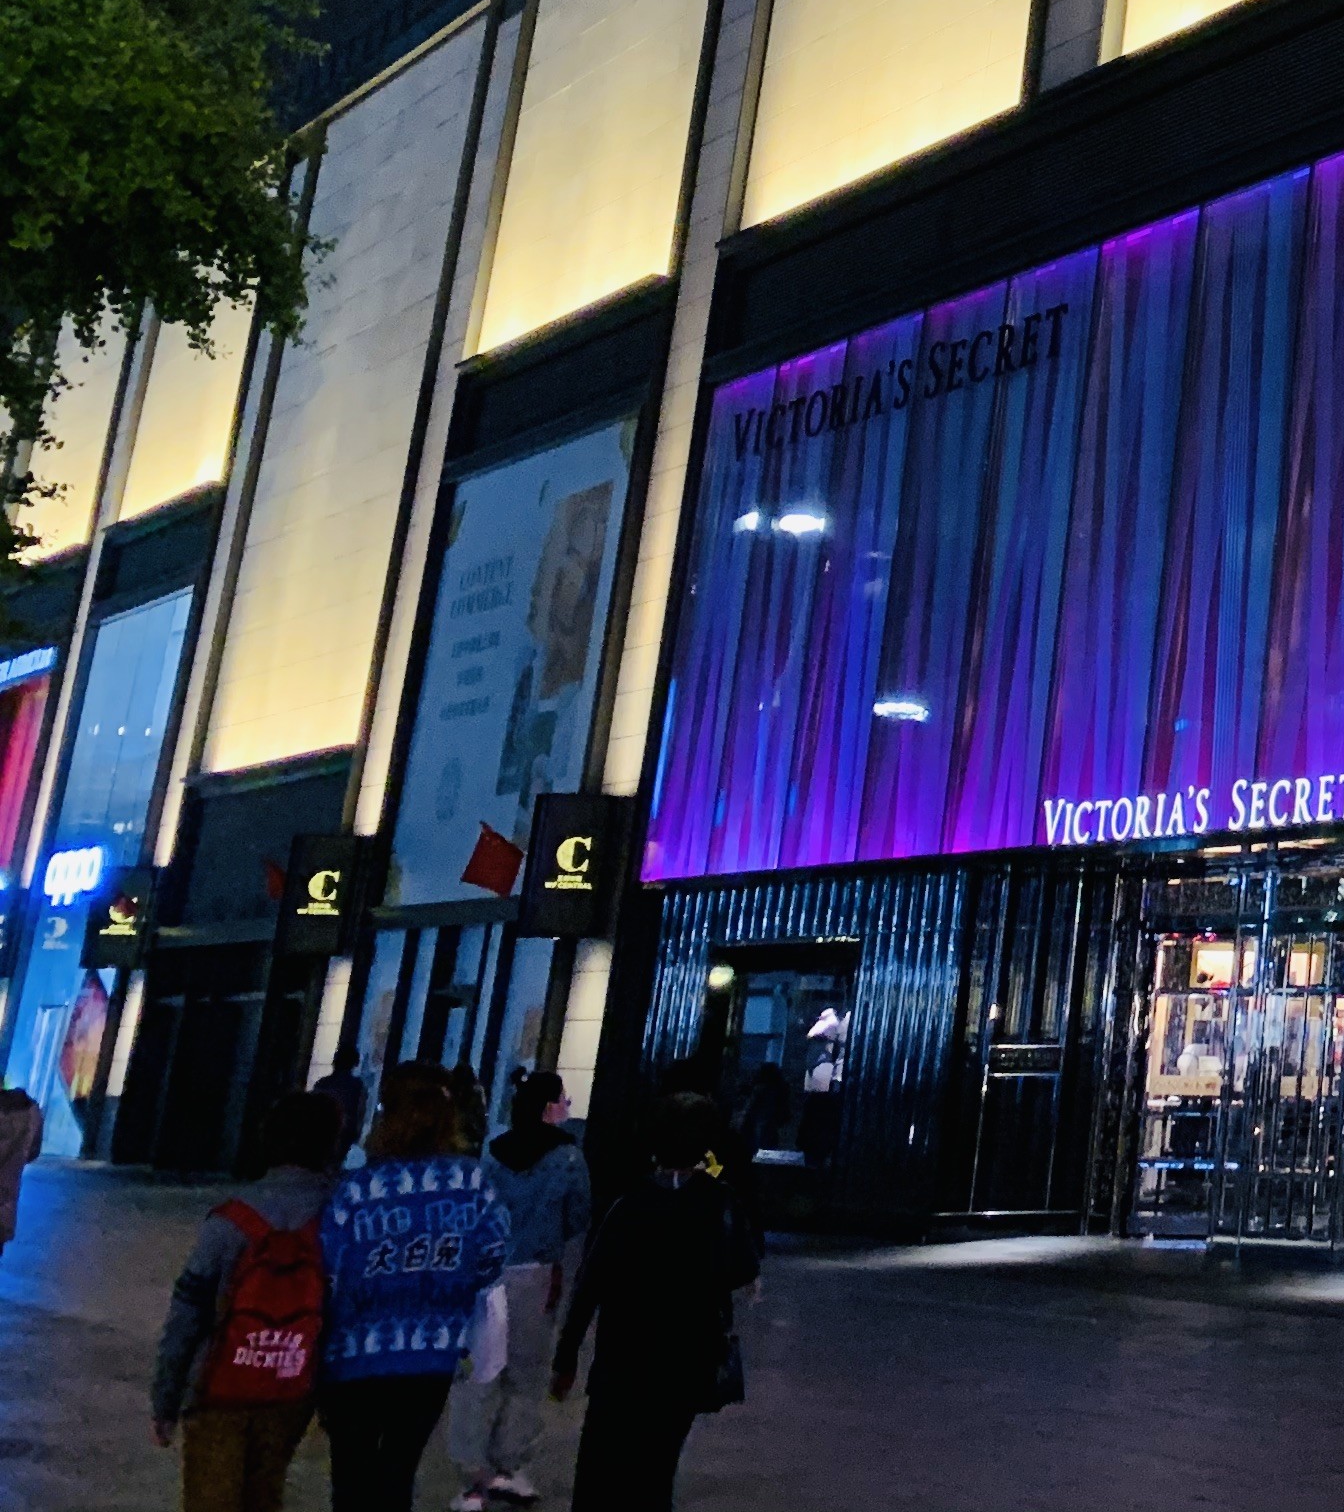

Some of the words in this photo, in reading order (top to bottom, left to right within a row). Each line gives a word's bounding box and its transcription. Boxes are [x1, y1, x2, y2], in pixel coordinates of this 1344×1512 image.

[734, 359, 912, 461] VICTORIA'S
[923, 303, 1069, 399] SECRET
[1044, 785, 1209, 846] VICTORIA'S
